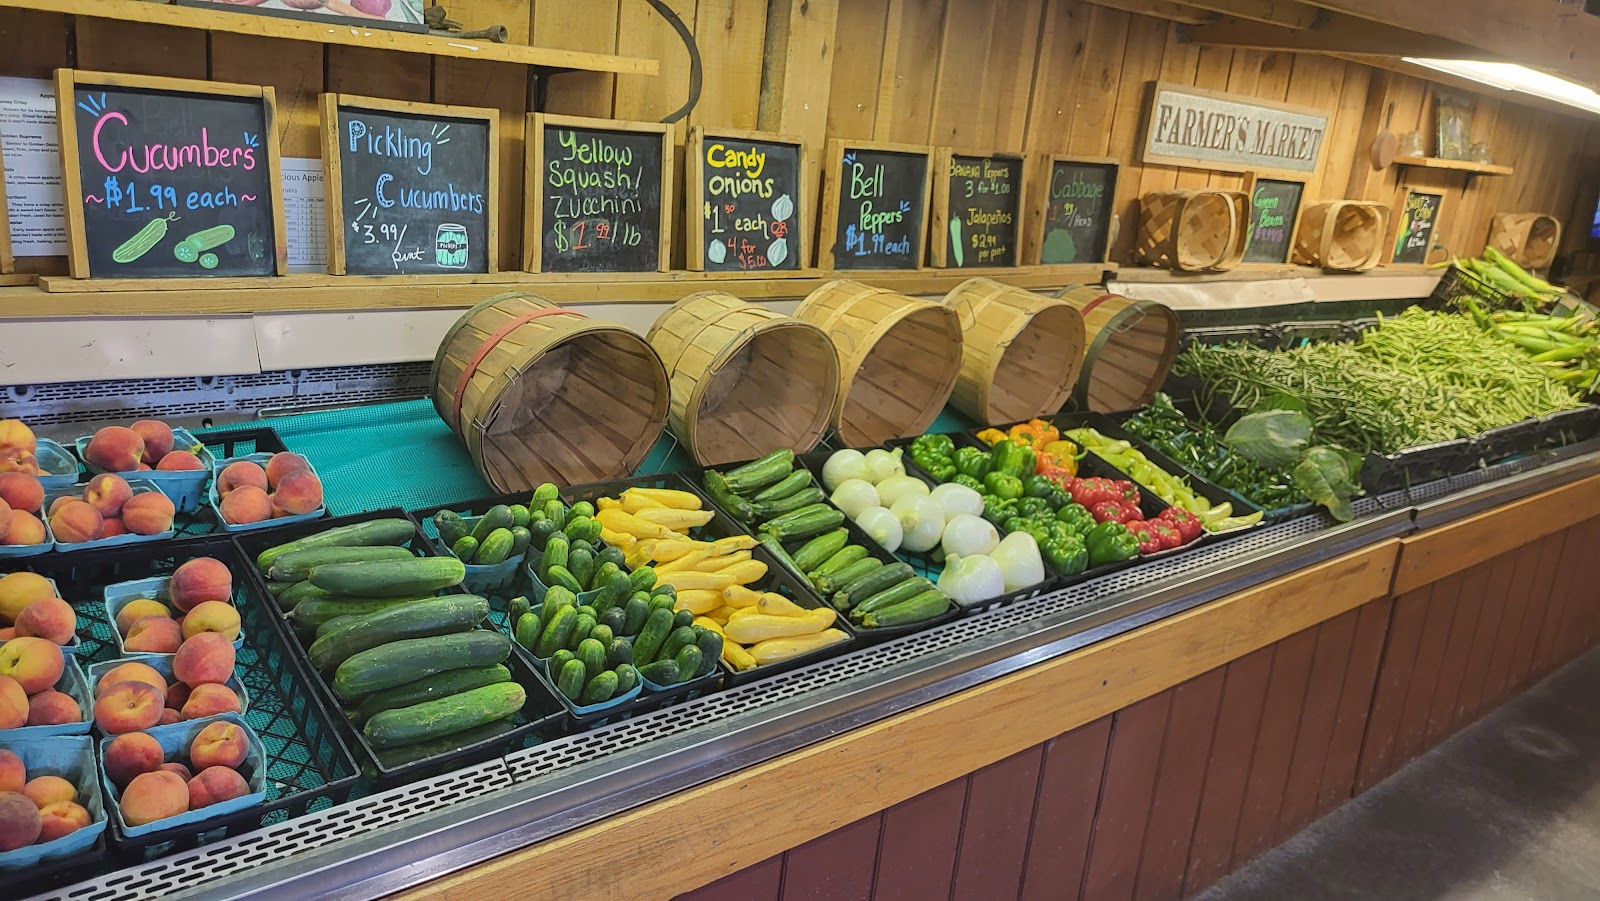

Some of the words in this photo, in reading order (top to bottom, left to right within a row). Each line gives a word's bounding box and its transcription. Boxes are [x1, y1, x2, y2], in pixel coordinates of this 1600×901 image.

[93, 112, 256, 173] Cucumbers
[349, 120, 432, 175] Pickling
[559, 130, 632, 166] Yellow
[1155, 104, 1250, 153] FARMER'S
[1250, 119, 1322, 161] MARKET
[707, 144, 765, 179] Candy
[104, 176, 177, 213] $1.99
[186, 186, 237, 210] each
[375, 173, 483, 214] Cucumbers
[850, 163, 885, 199] Bell
[965, 180, 975, 198] 3
[1052, 169, 1104, 215] Cabbage
[1253, 186, 1279, 209] Green
[550, 193, 642, 218] Zucchini
[860, 200, 903, 234] Peppers
[966, 208, 1012, 234] Jalapeños
[1258, 208, 1284, 228] Beans
[735, 213, 770, 240] each
[845, 223, 885, 256] $1.99
[885, 235, 910, 254] each
[392, 247, 426, 269] pint
[728, 237, 737, 256] 4
[741, 239, 756, 254] for
